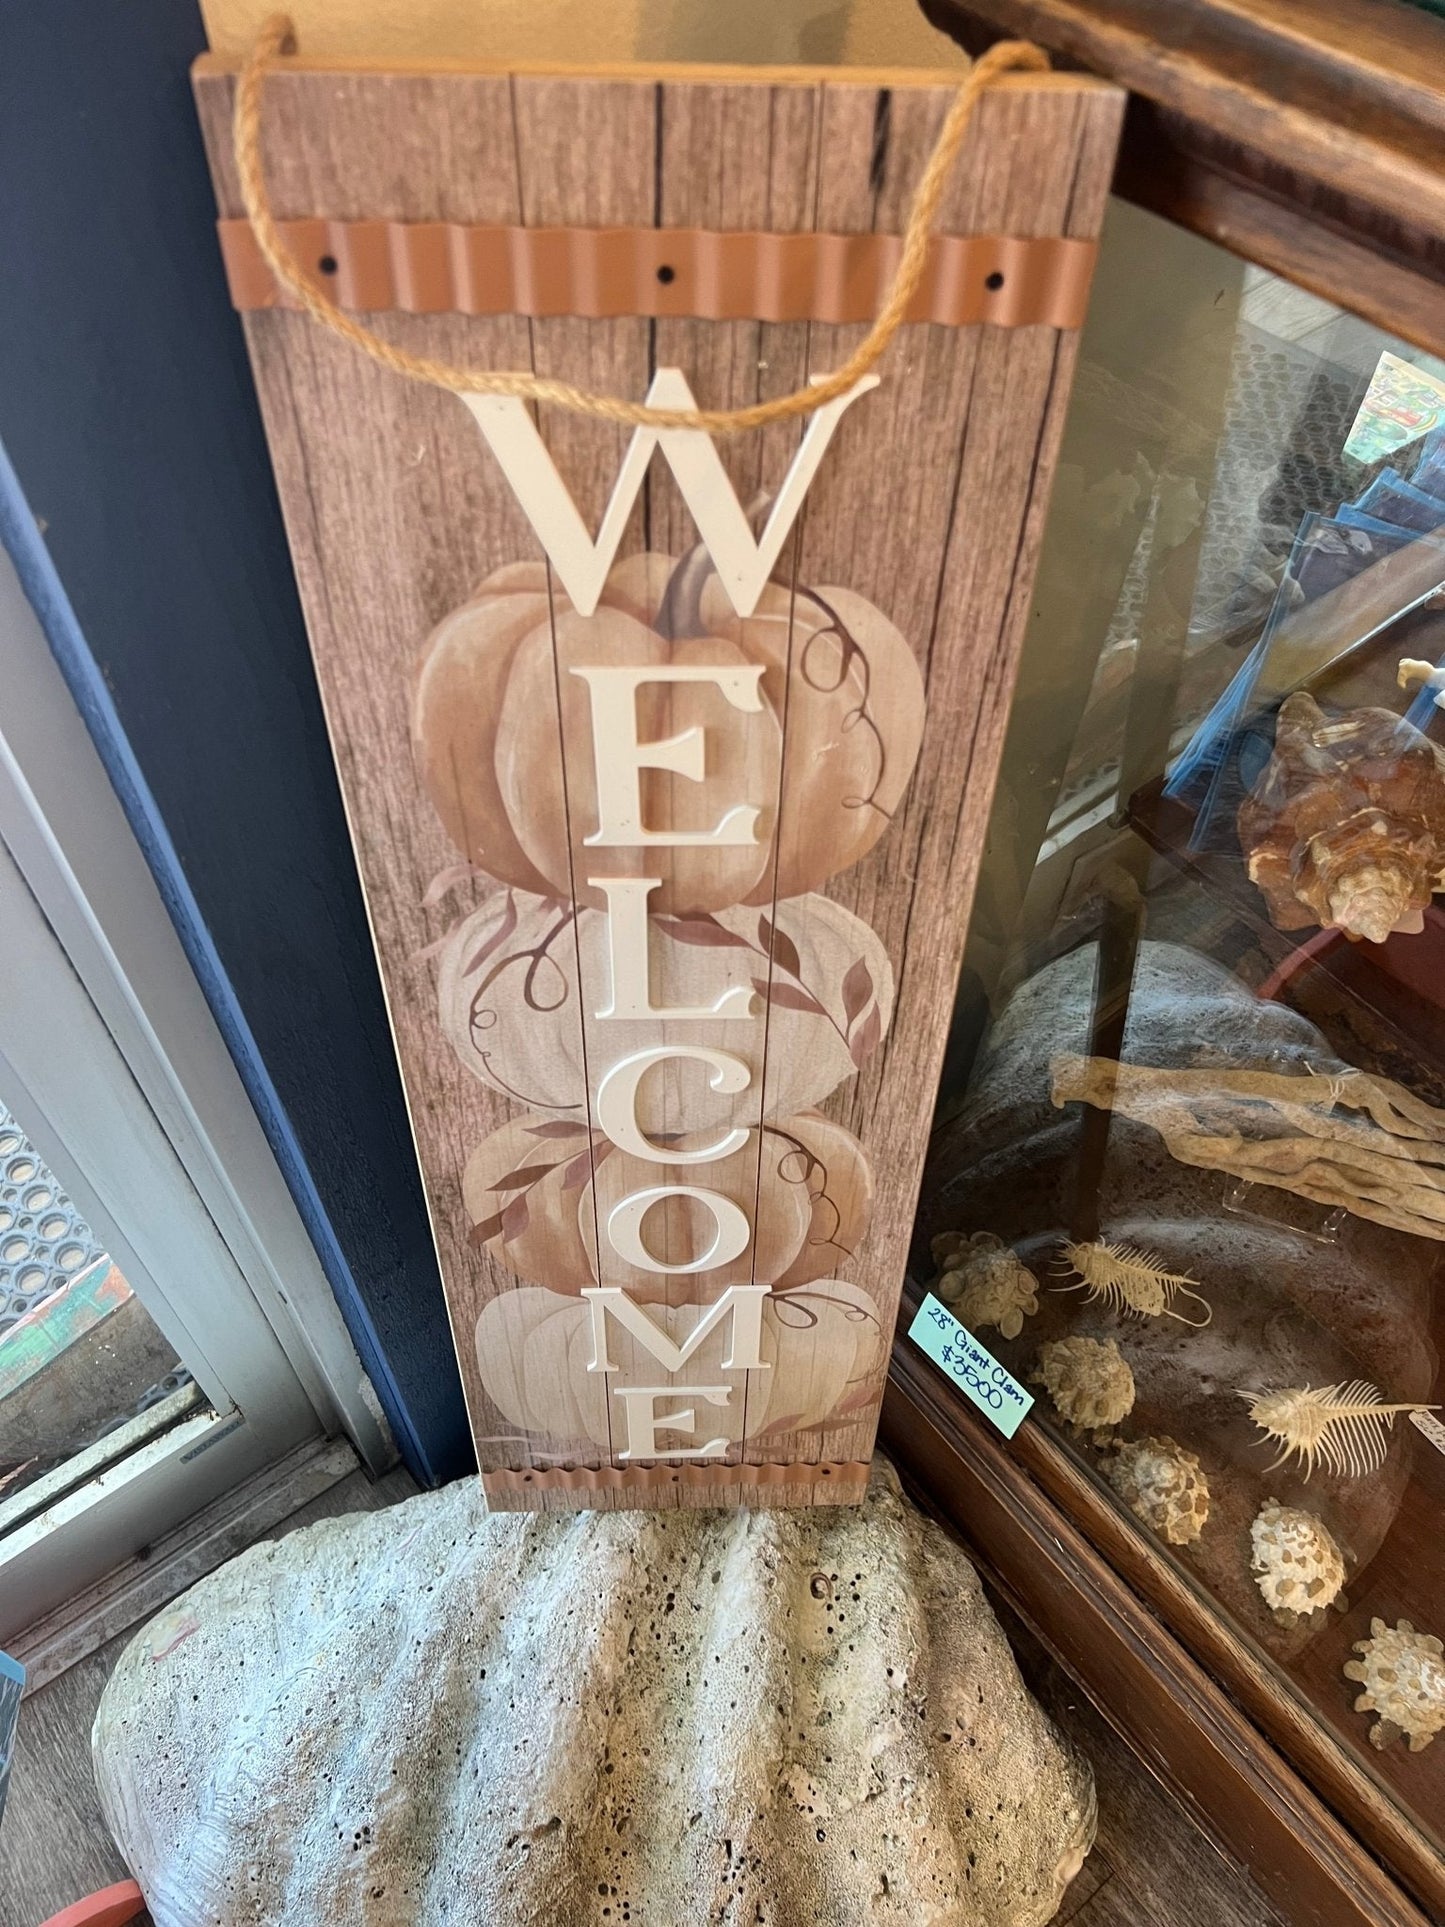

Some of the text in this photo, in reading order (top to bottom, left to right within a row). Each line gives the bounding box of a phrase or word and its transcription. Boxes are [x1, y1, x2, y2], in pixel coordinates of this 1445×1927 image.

[456, 367, 881, 1460] WELCOME
[927, 1307, 1025, 1406] 28" Giant Clam
[941, 1344, 1003, 1409] $3500
